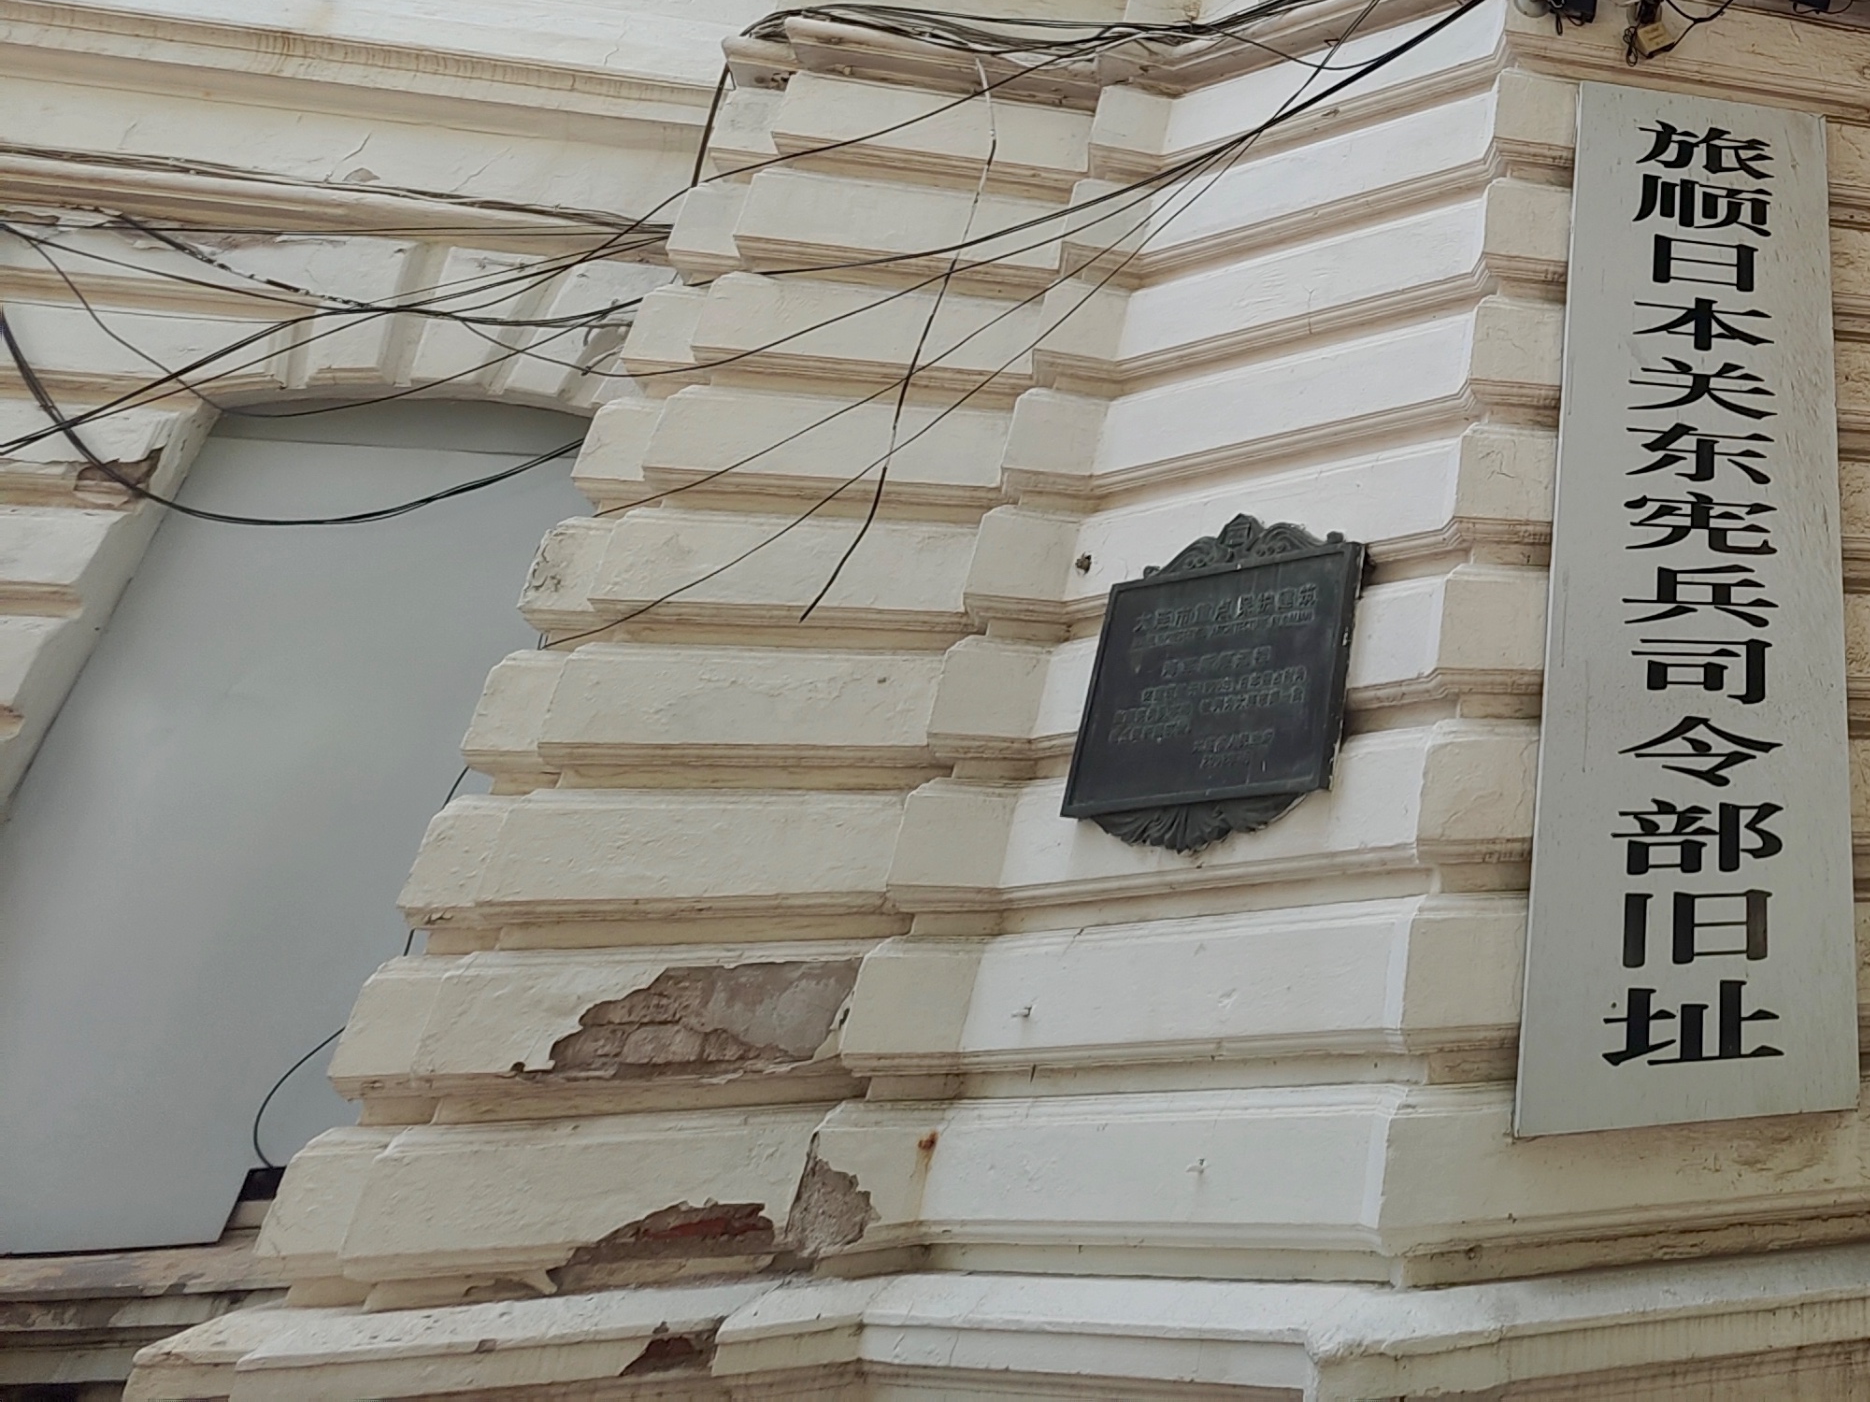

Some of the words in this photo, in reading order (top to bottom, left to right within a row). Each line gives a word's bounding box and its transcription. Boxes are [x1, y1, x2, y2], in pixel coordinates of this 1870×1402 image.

[1601, 120, 1785, 1068] 旅顺日本关东宪兵司令部旧址
